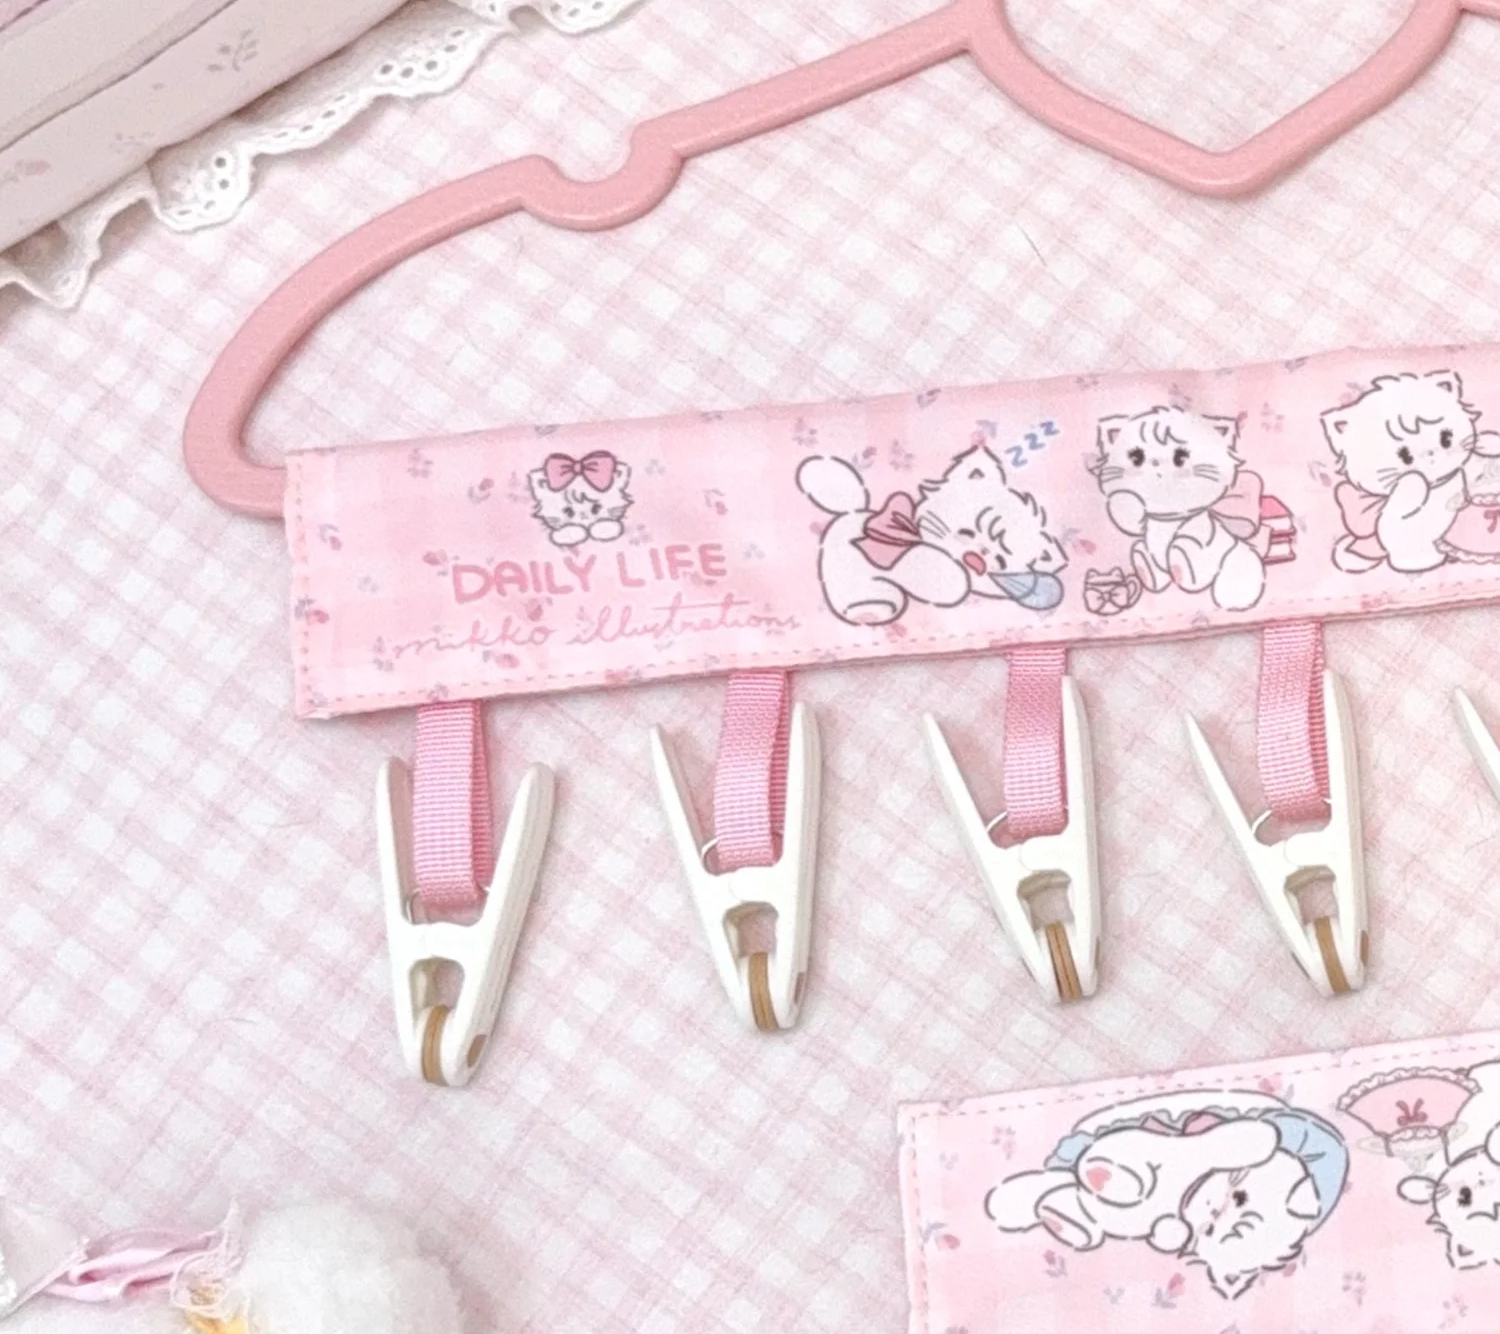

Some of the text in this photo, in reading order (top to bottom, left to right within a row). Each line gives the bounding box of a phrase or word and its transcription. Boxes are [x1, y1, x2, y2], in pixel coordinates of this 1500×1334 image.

[452, 543, 728, 604] DAILY LIFE
[394, 592, 801, 658] mikko illustrations
